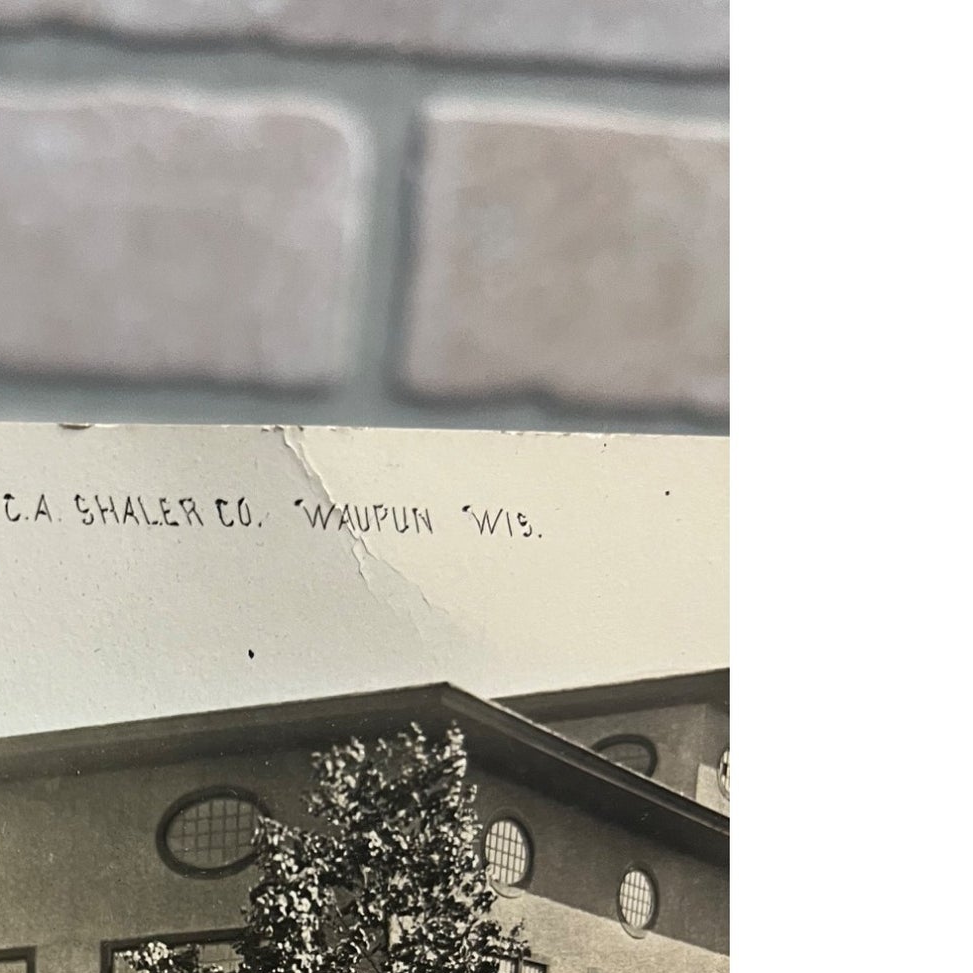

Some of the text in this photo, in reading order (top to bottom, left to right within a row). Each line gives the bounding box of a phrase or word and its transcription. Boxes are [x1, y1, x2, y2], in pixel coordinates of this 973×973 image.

[73, 494, 204, 526] SHALER
[214, 496, 263, 528] CO.
[294, 498, 434, 535] WAUPUN
[461, 504, 543, 538] WIS.
